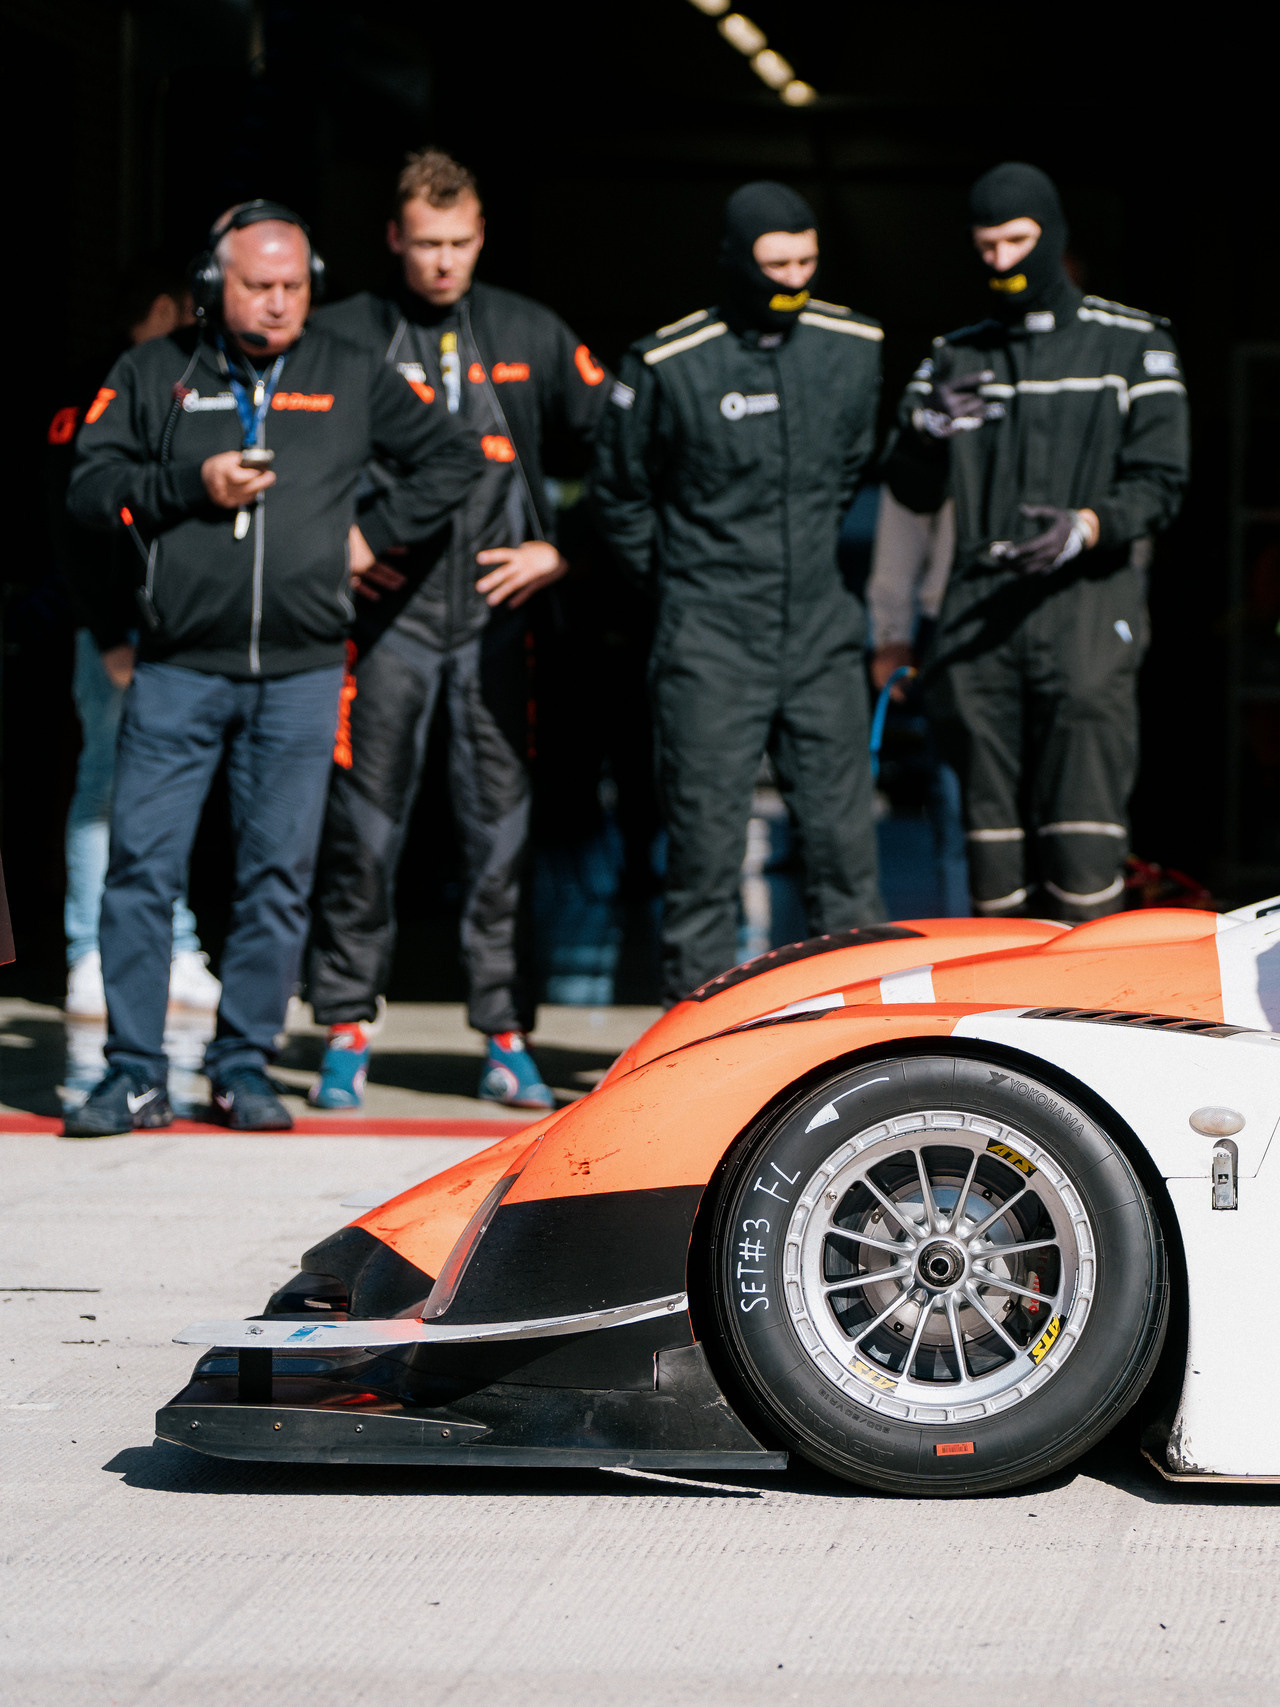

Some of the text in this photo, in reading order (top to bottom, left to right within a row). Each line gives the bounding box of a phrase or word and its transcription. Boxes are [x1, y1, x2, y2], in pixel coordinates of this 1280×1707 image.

[1009, 1078, 1086, 1138] YOKOHAMA
[987, 1143, 1038, 1174] ATS
[753, 1161, 802, 1203] FL
[1031, 1315, 1061, 1366] ATS
